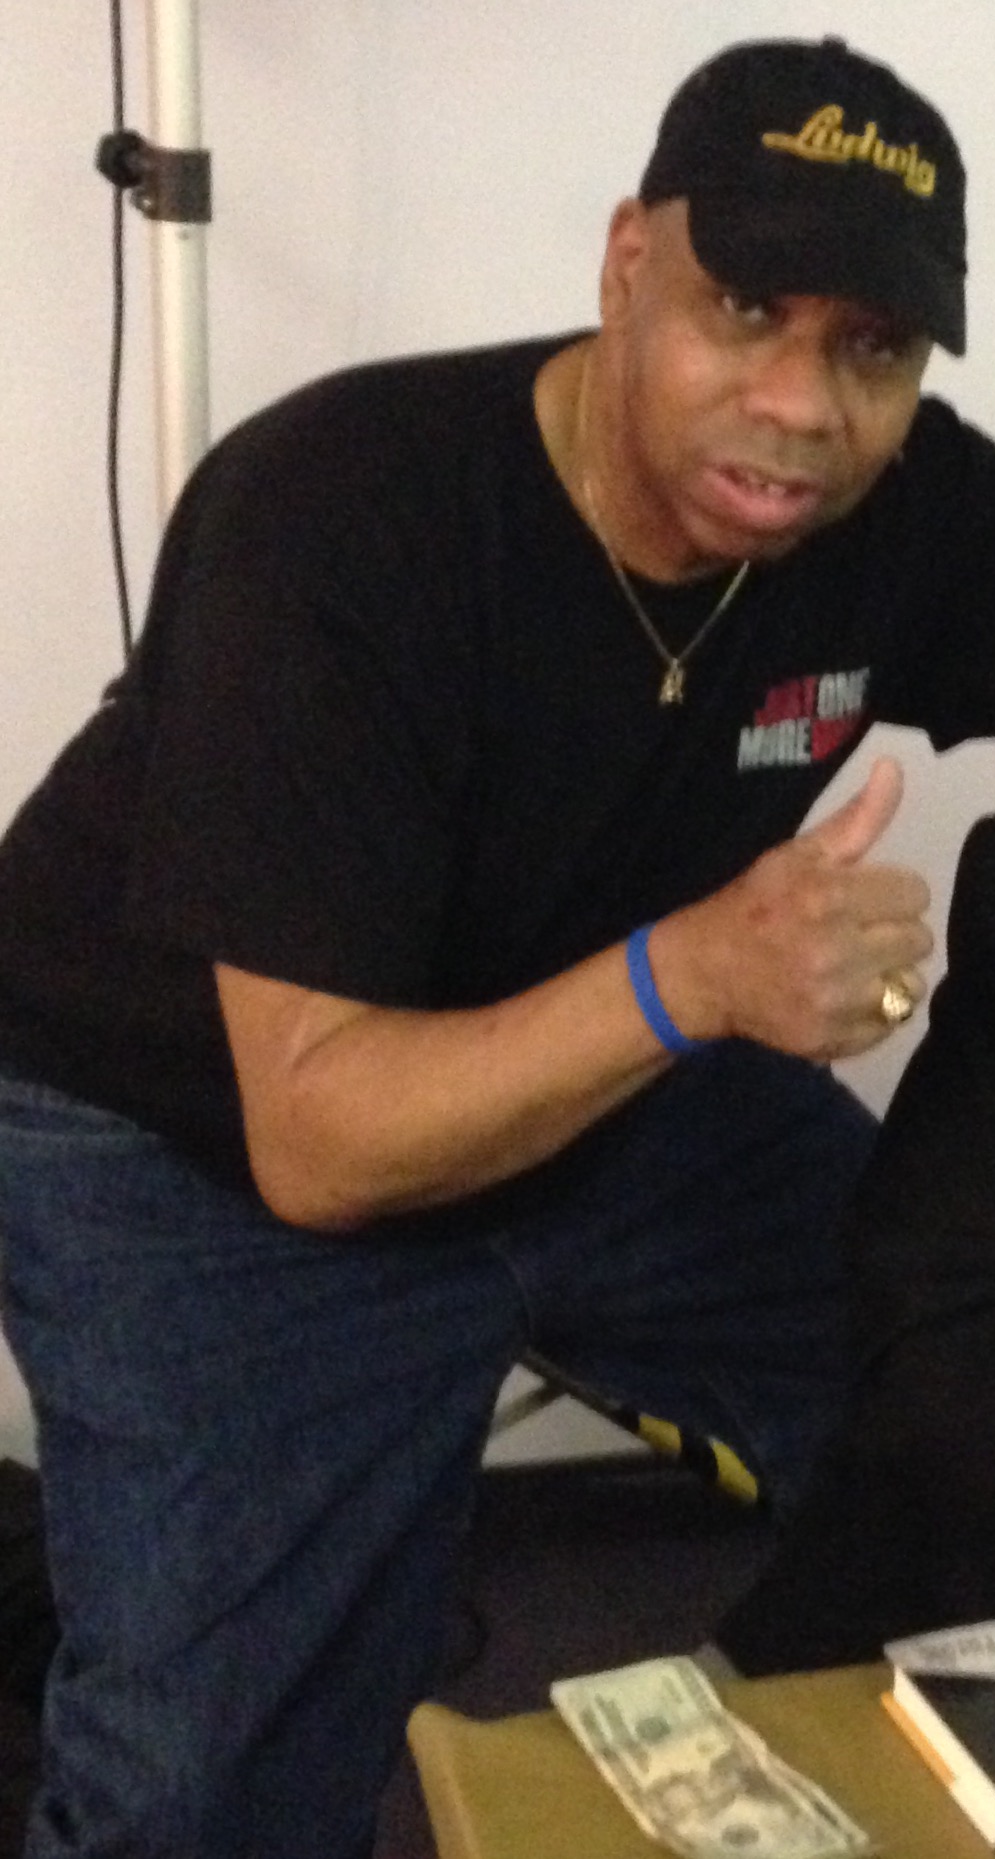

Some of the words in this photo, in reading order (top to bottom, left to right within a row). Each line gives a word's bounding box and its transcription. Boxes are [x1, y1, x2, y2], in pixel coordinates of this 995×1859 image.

[761, 103, 937, 198] Ludwig
[816, 666, 871, 722] ONE
[736, 717, 813, 773] MORE
